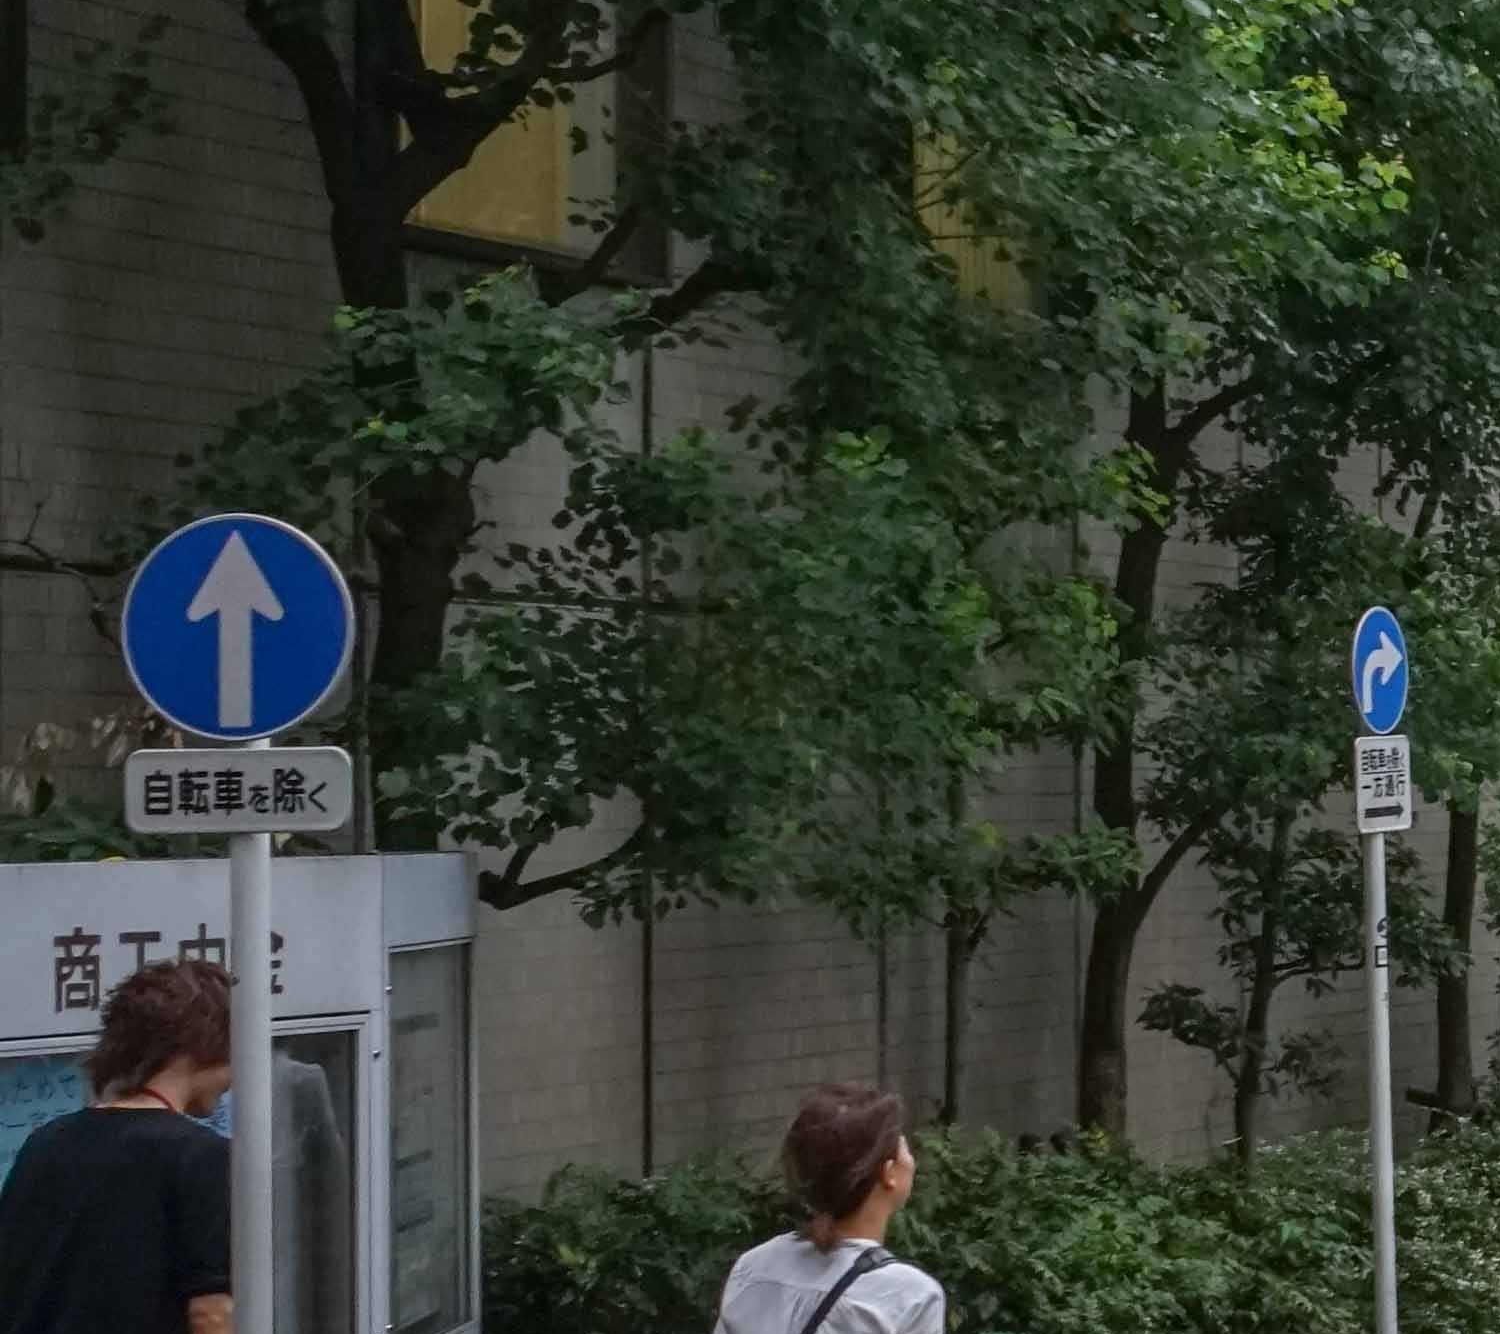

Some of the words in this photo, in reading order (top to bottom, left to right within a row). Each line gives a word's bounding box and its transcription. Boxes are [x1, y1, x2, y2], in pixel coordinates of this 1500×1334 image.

[142, 767, 329, 817] 自転車を除く
